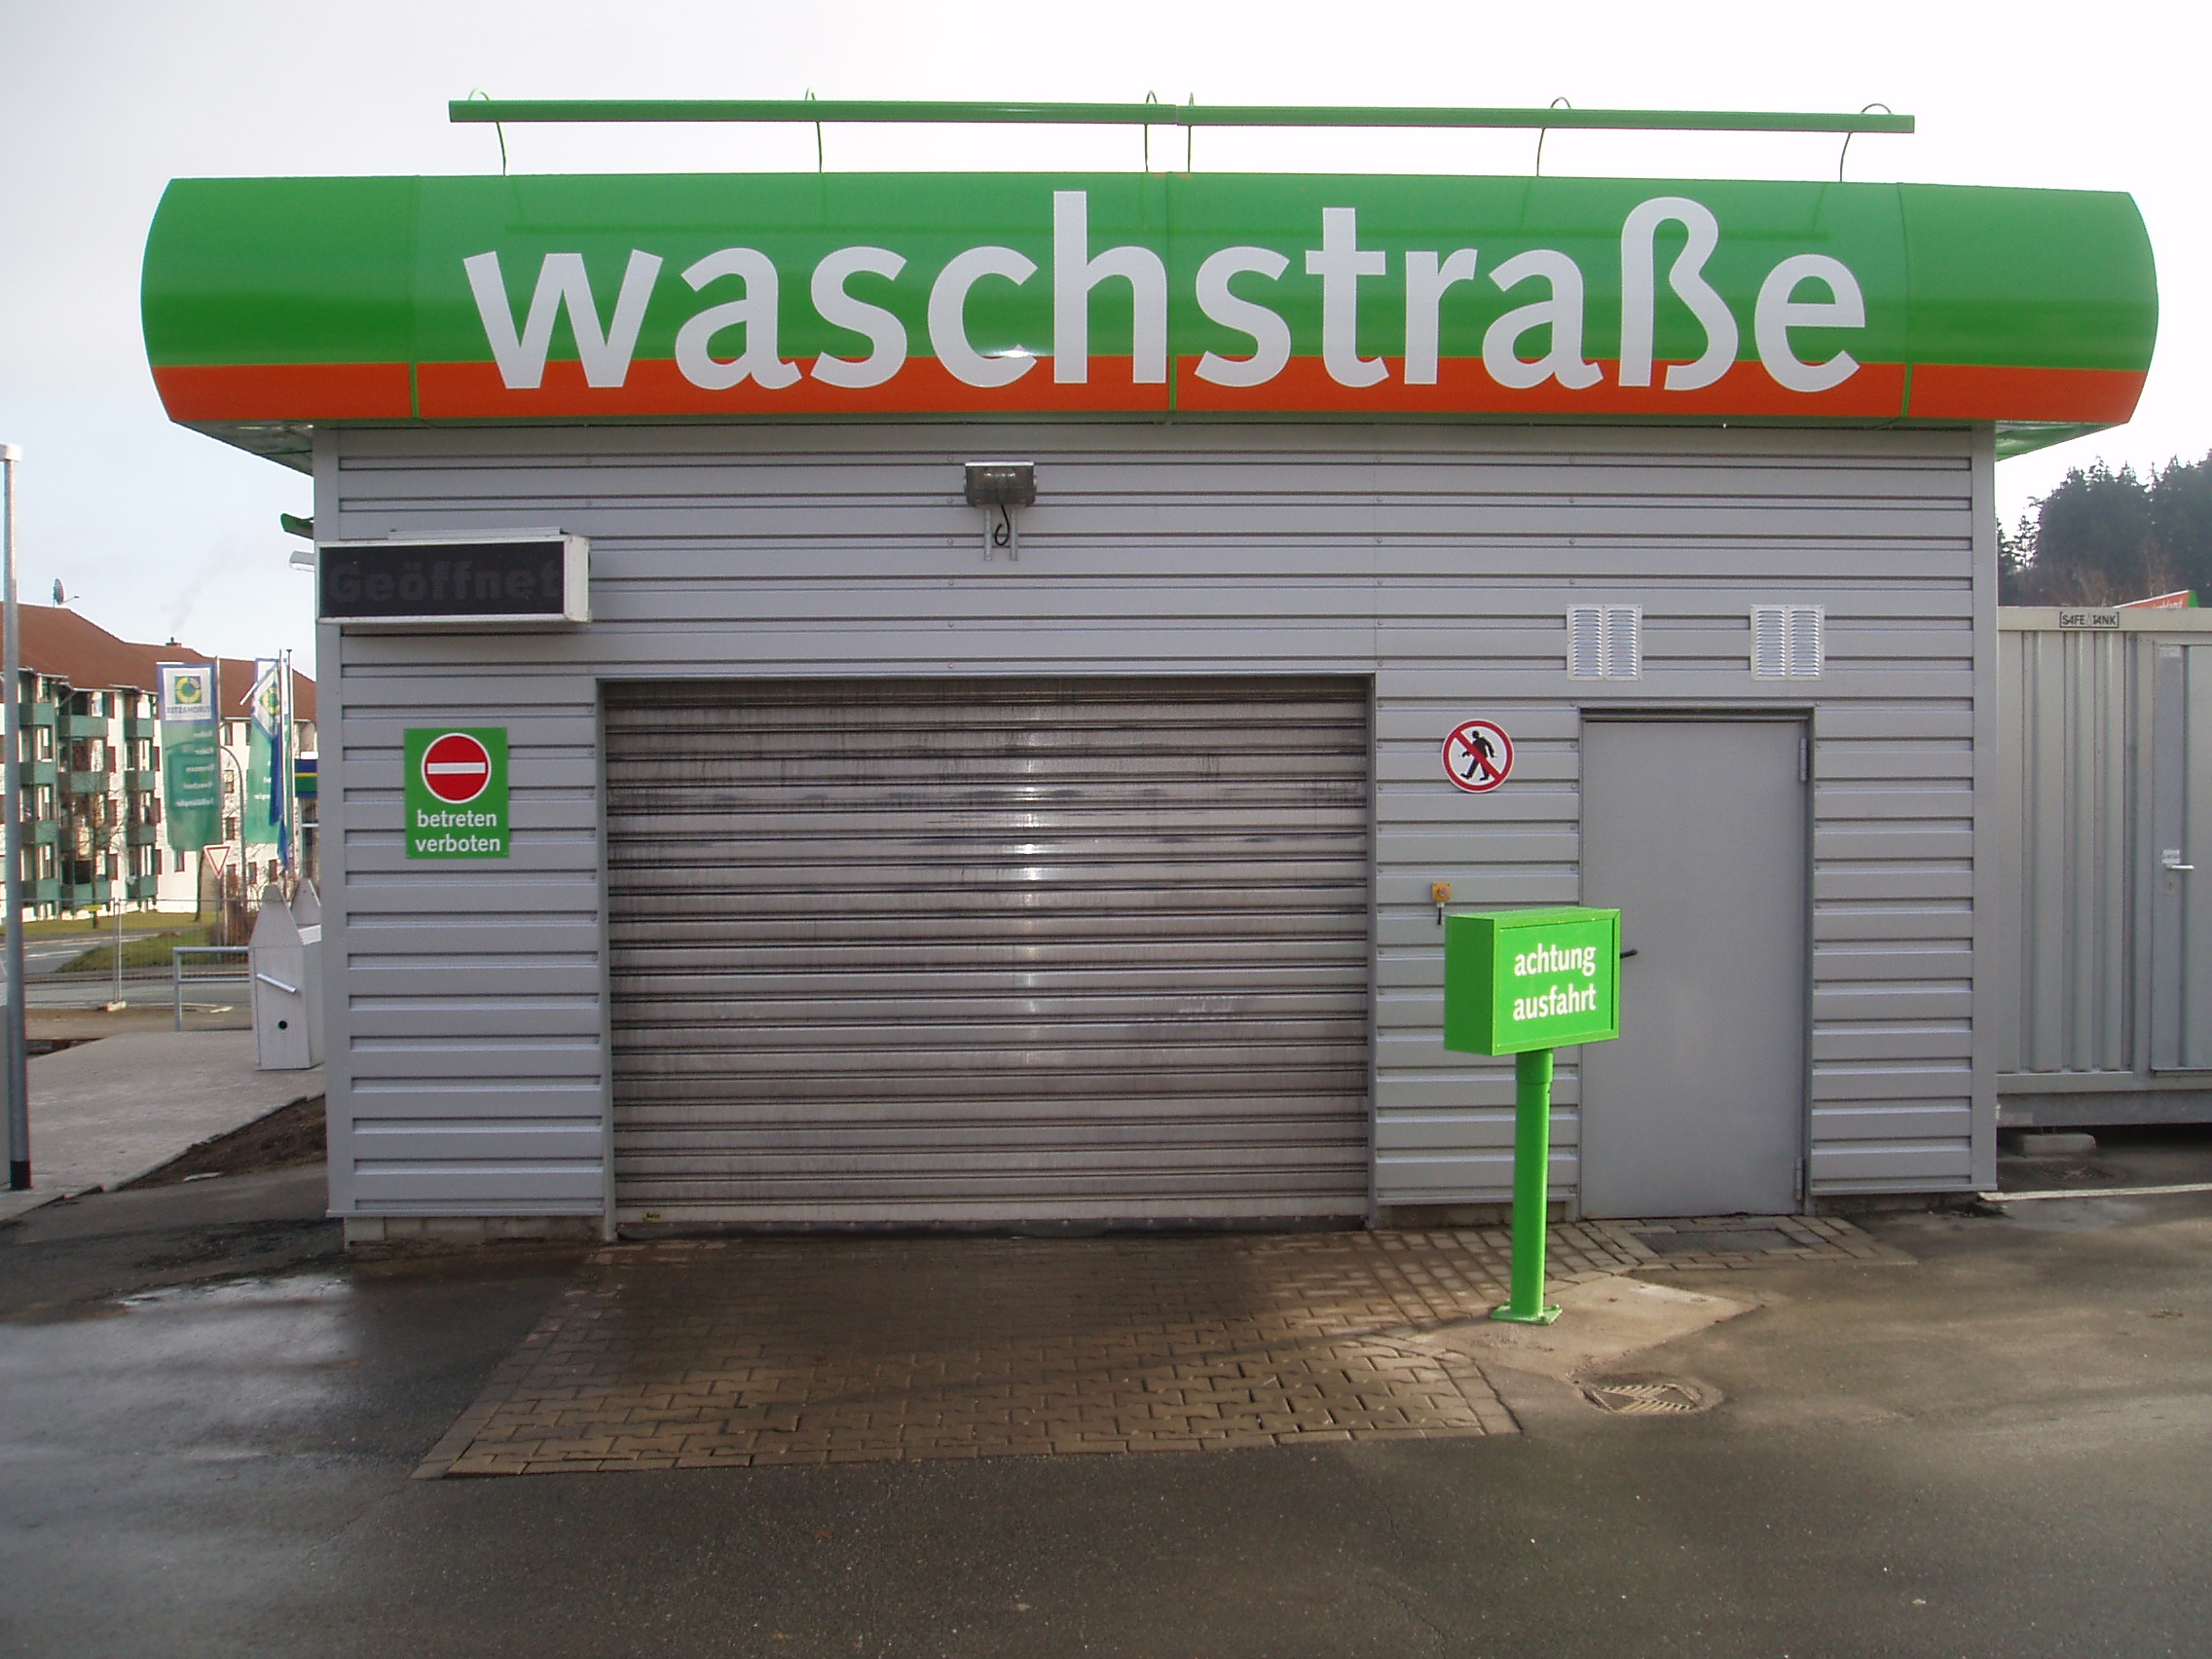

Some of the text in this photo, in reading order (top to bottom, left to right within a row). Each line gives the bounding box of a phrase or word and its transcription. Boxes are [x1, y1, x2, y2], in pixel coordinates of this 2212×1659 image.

[462, 189, 1867, 392] waschstraße
[328, 561, 562, 602] Geöffnet
[2062, 614, 2117, 625] SAFE TANK
[417, 808, 498, 828] betreten
[415, 833, 501, 853] verboten
[1513, 942, 1597, 977] achtung
[1512, 982, 1597, 1021] ausfahrt
